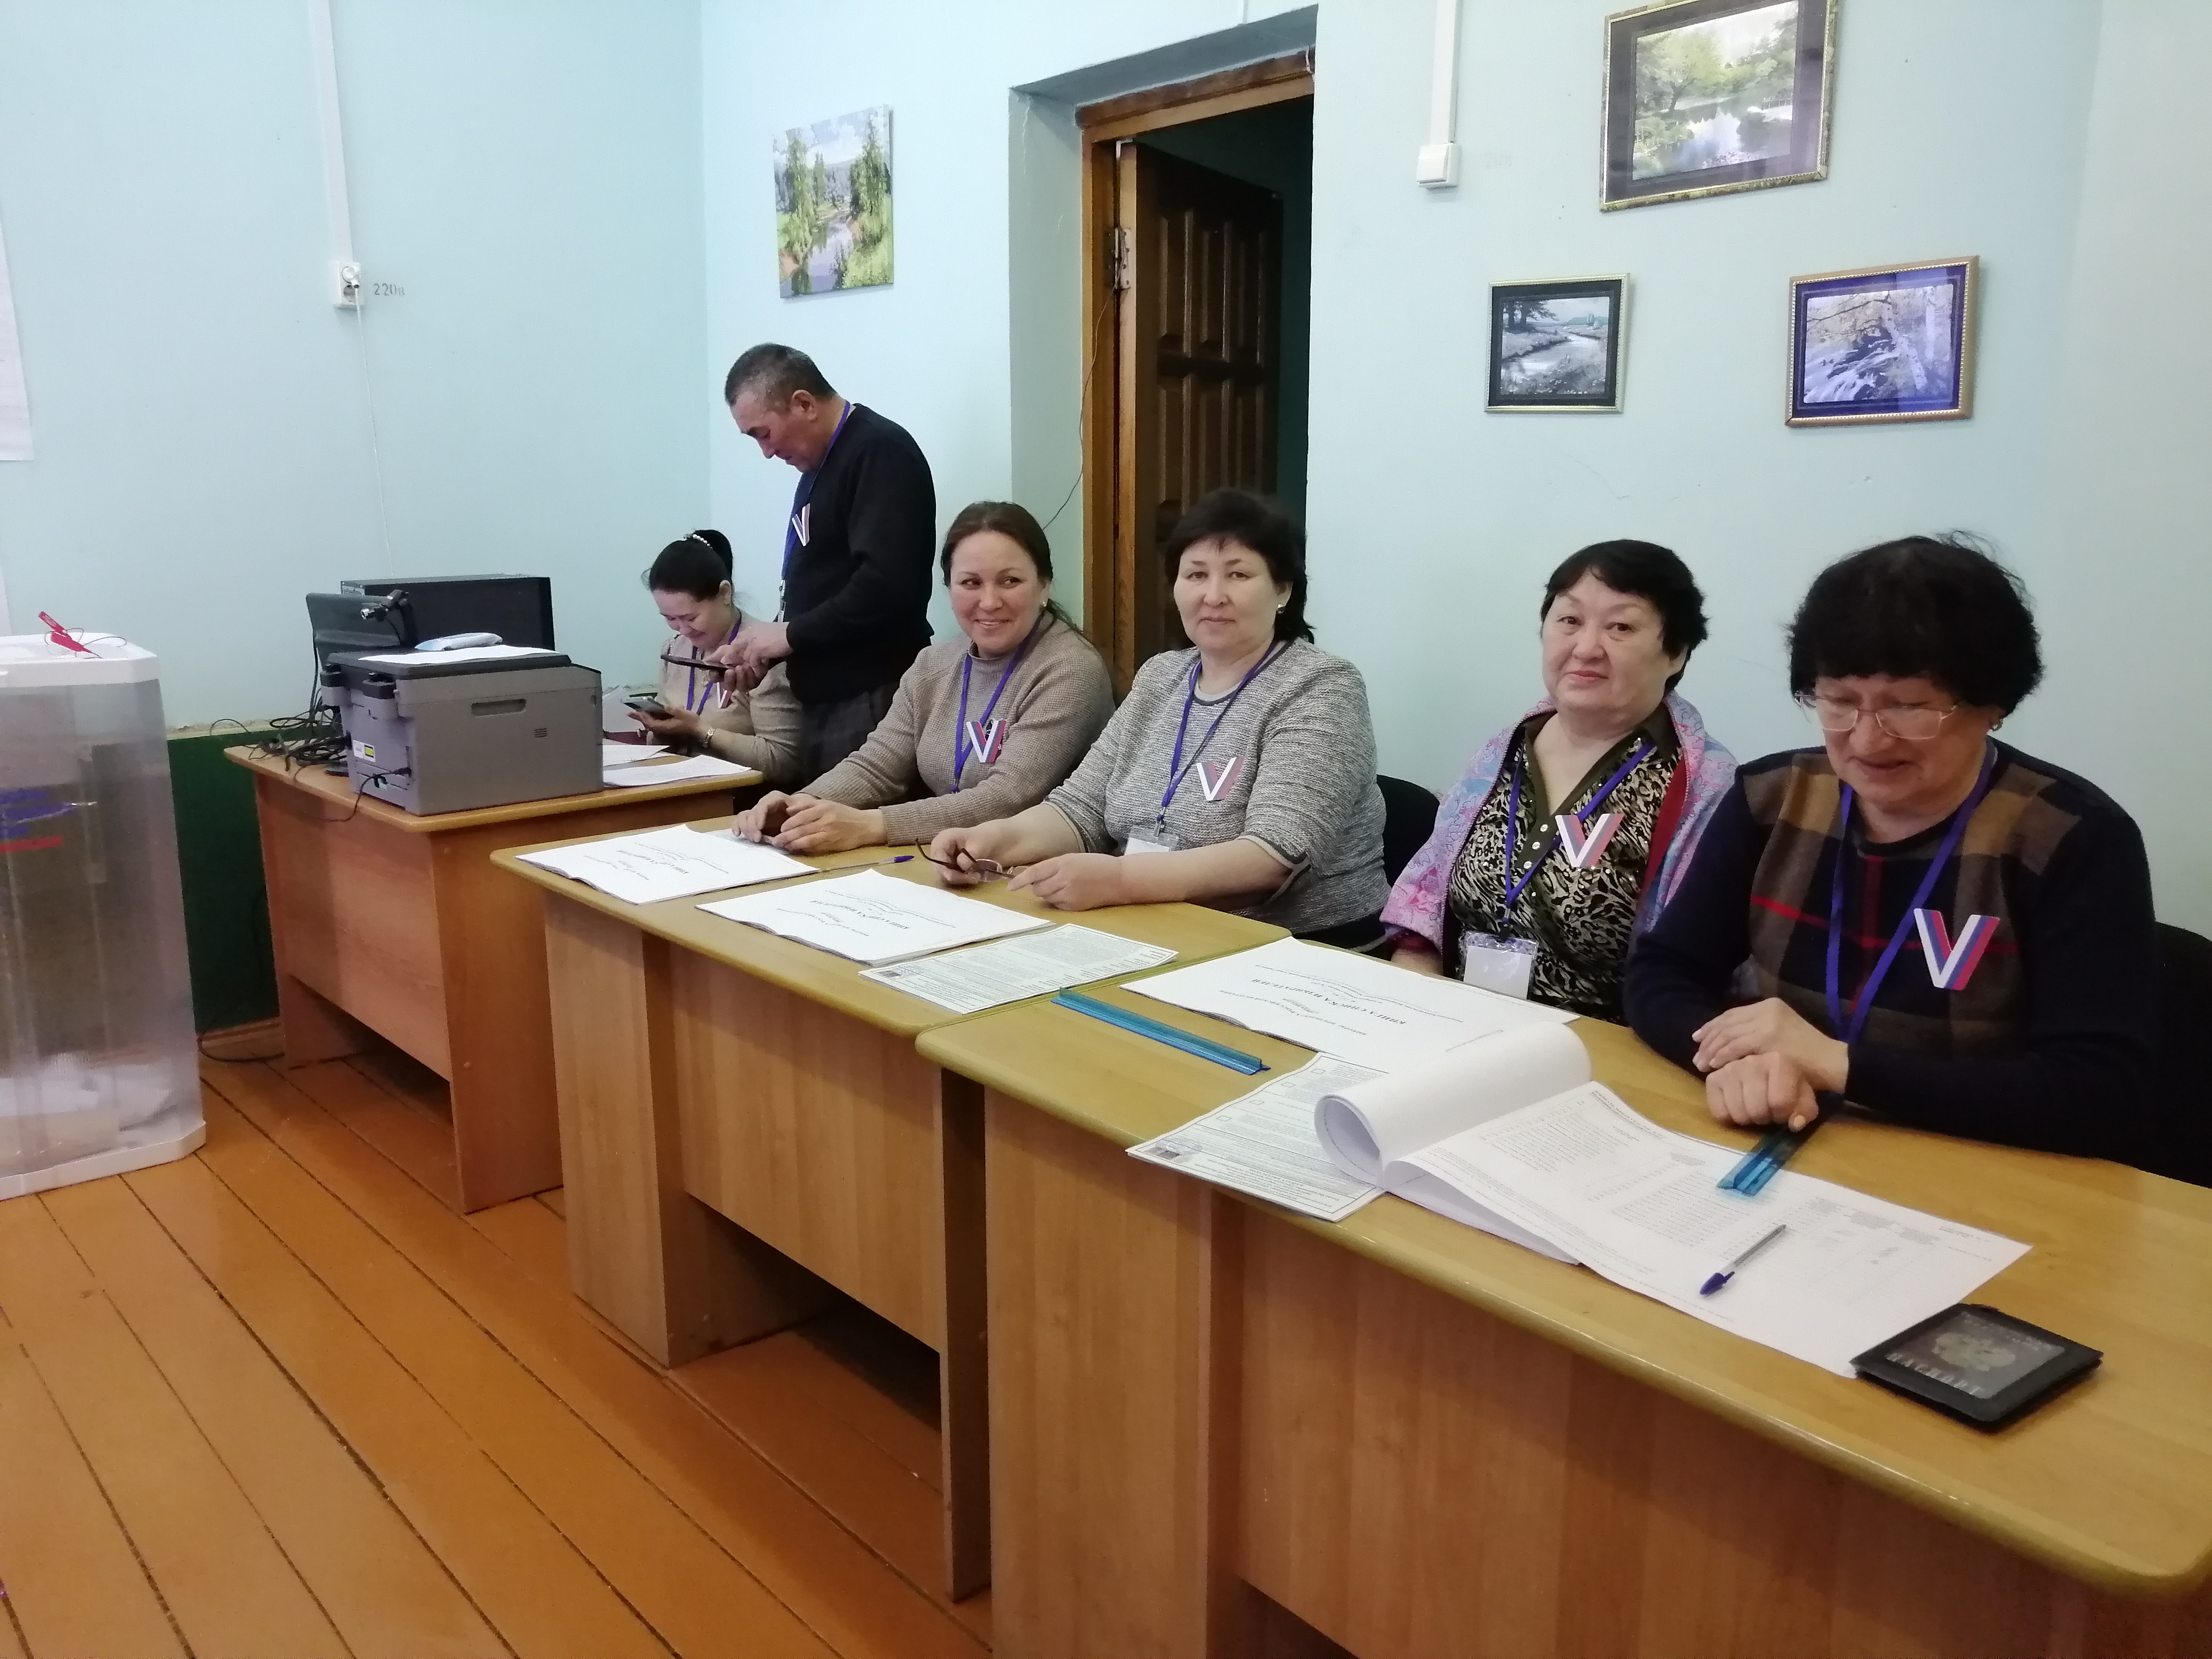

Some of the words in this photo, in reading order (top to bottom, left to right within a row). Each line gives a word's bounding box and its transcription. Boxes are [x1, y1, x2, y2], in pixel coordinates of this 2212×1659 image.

[1252, 978, 1322, 998] ИЗБИРАТЕЛЕЙ
[1324, 997, 1367, 1012] СПИСКА
[1370, 1010, 1407, 1025] КНИГА
